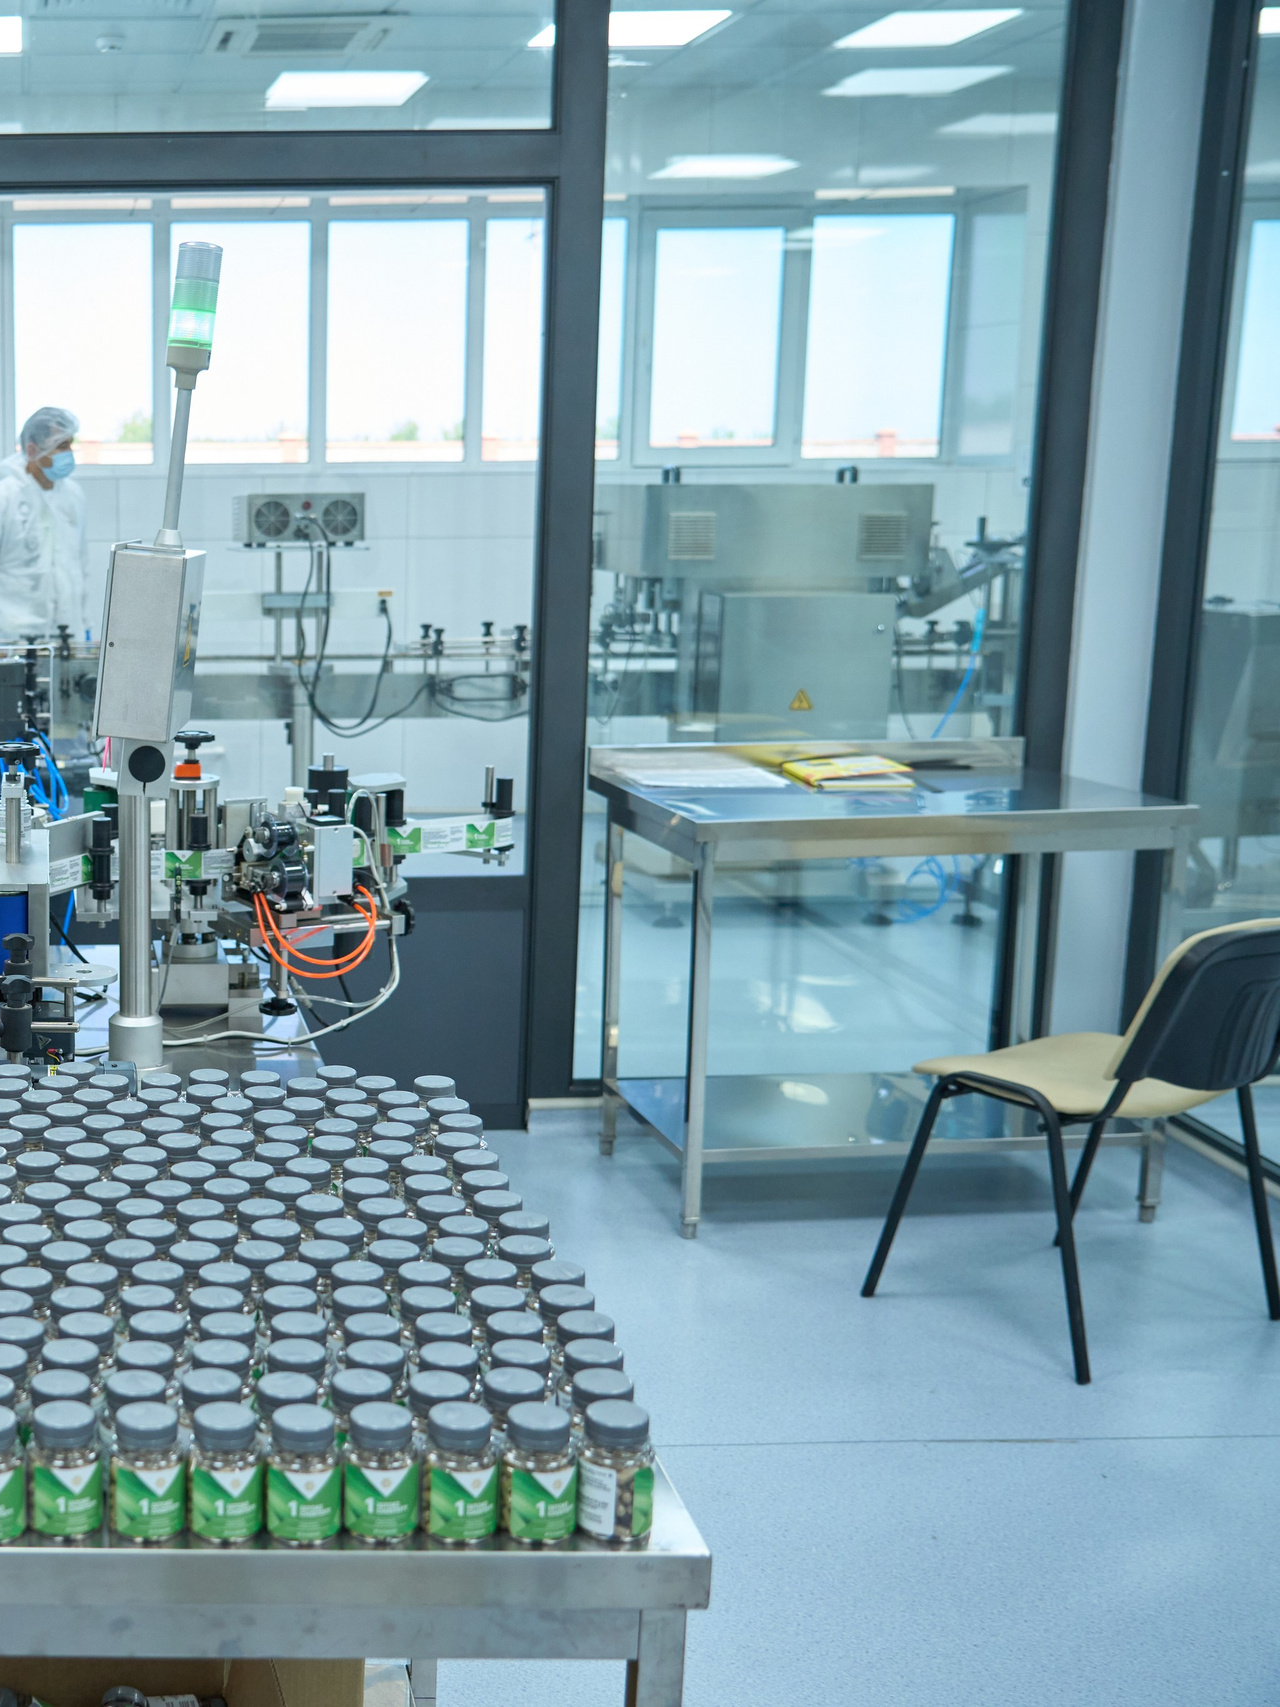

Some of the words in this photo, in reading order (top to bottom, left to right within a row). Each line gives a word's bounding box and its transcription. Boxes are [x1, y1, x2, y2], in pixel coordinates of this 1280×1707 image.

[56, 1496, 66, 1514] 1
[139, 1498, 149, 1515] 1
[214, 1499, 224, 1516] 1
[288, 1500, 298, 1517] 1
[365, 1497, 374, 1514] 1
[454, 1500, 464, 1517] 1
[536, 1501, 546, 1517] 1
